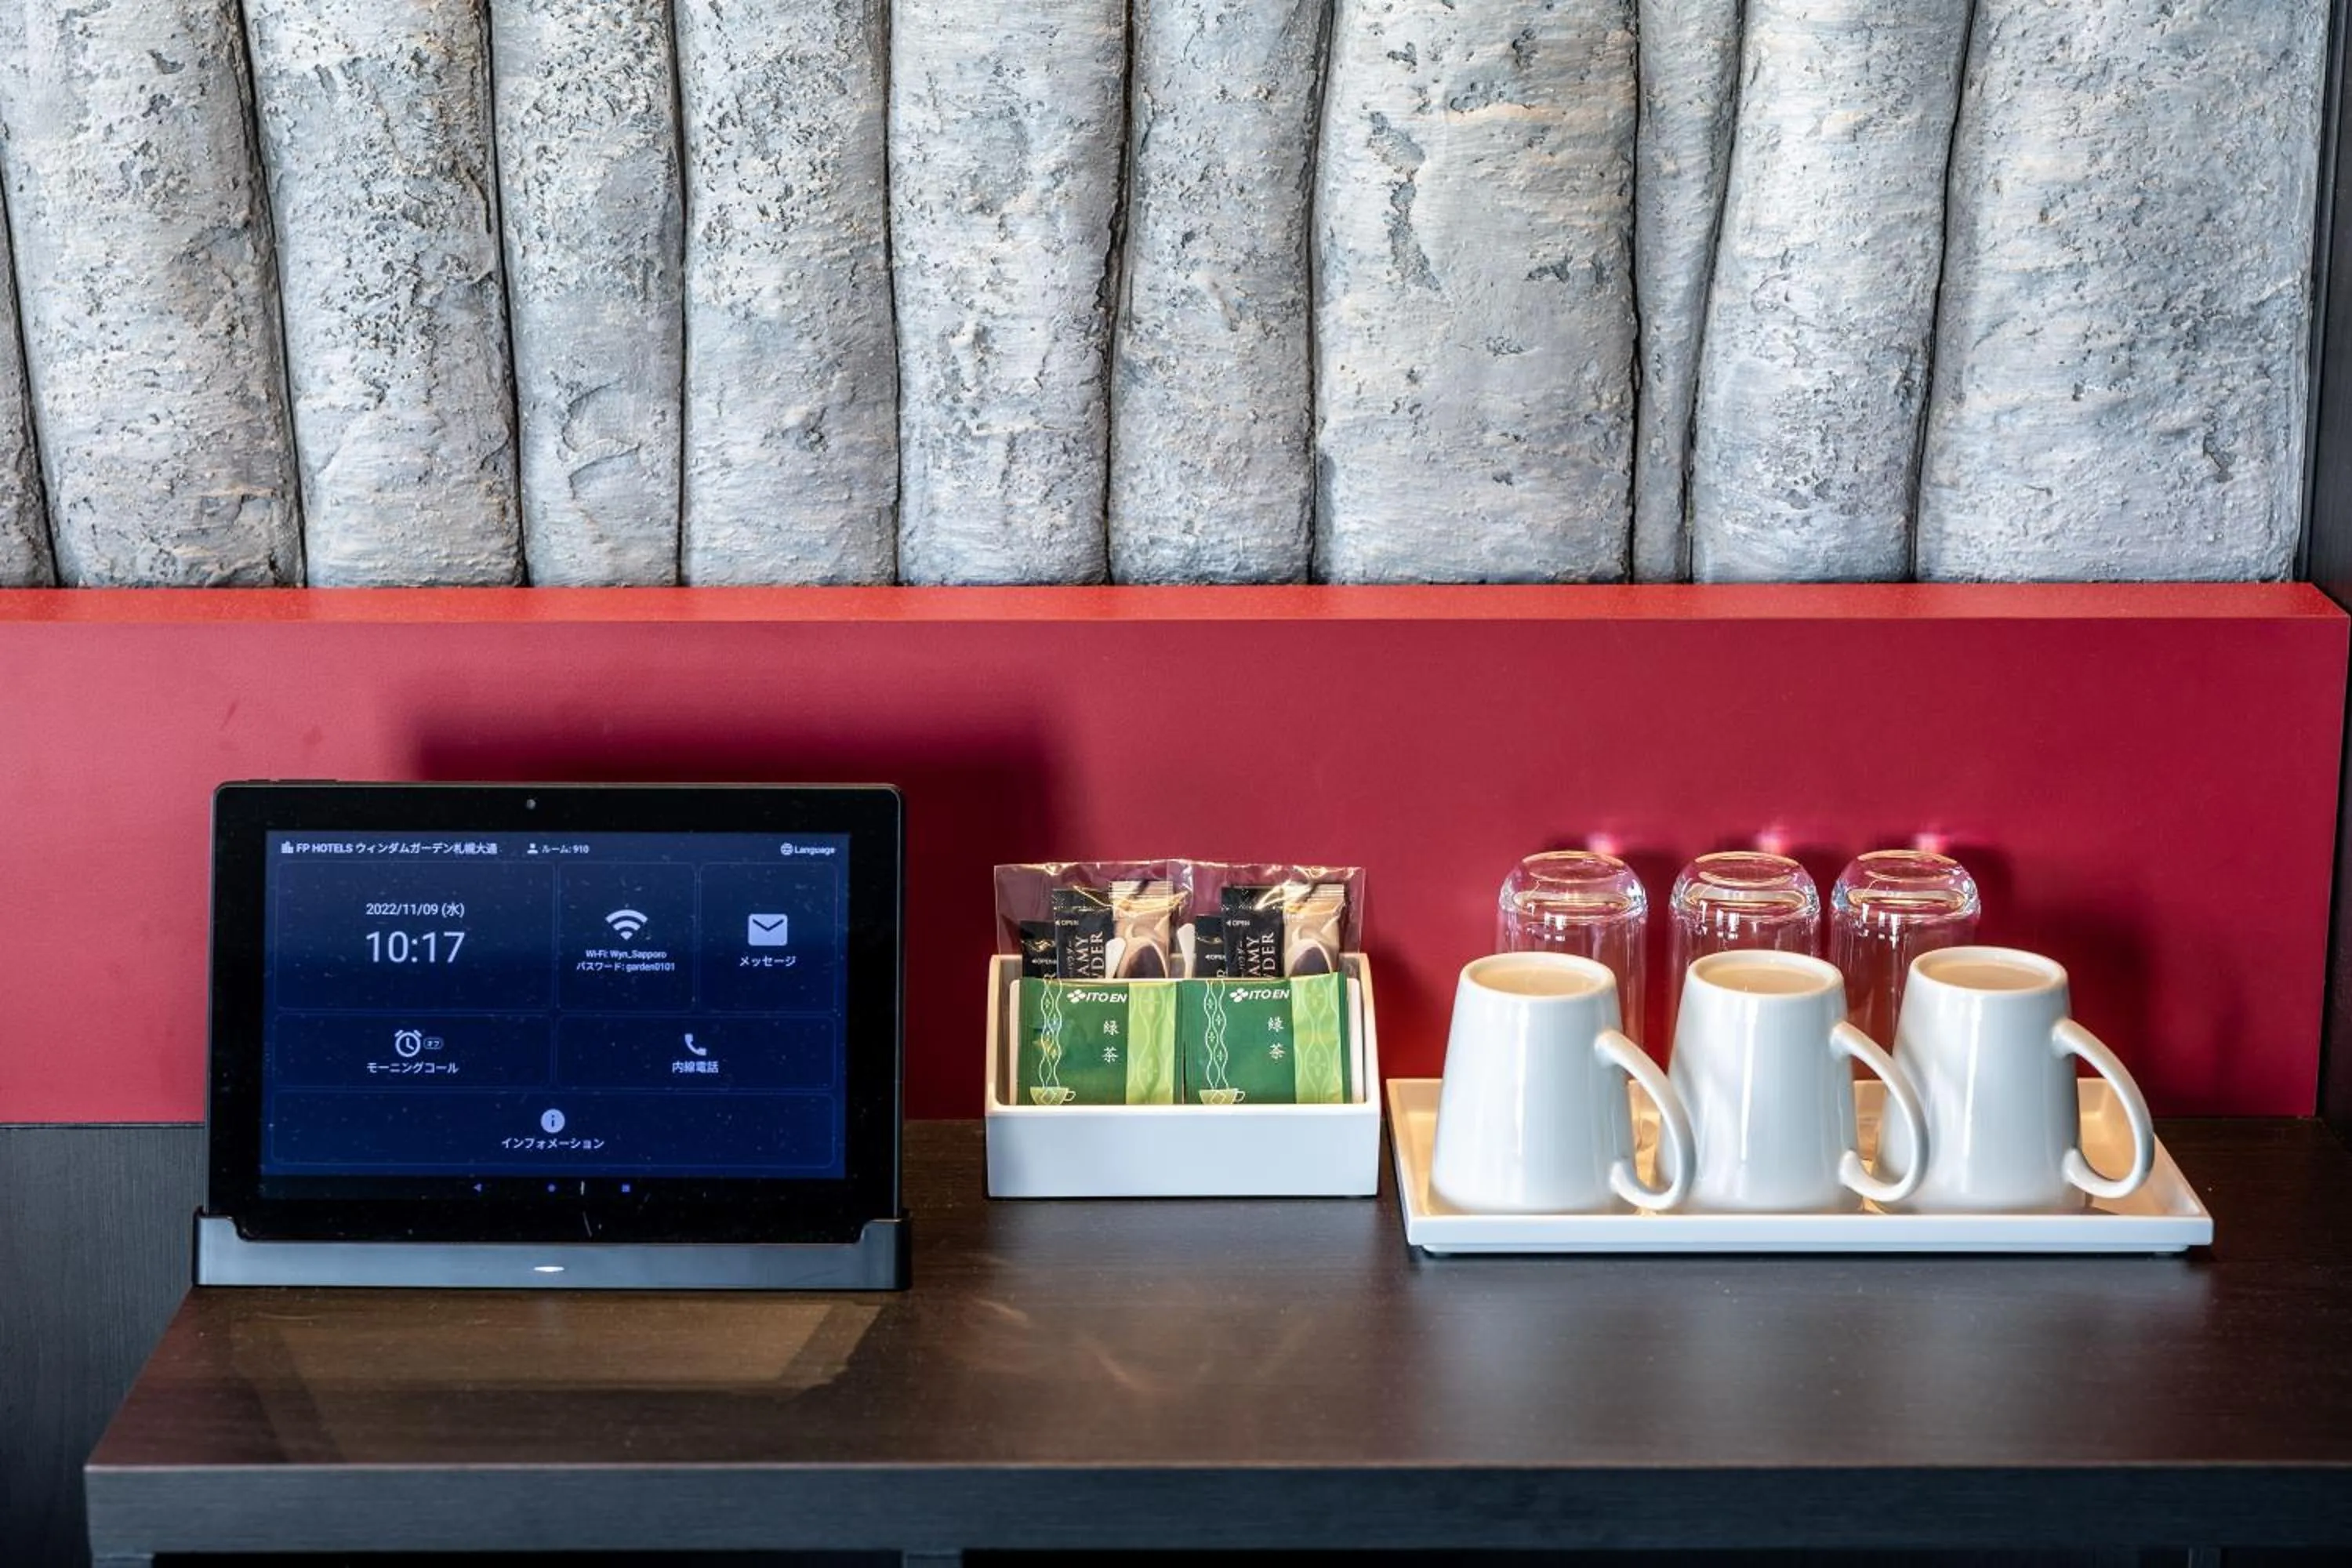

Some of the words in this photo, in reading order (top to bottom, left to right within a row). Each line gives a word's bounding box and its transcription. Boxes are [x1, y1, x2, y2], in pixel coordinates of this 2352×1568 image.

[296, 844, 310, 853] FP
[312, 844, 353, 854] HOTELS
[572, 844, 590, 854] 910
[794, 845, 835, 856] Language
[366, 903, 438, 916] 2022/11/09
[441, 903, 465, 918] (水)
[365, 931, 465, 964] 10:17
[609, 949, 667, 960] Wyn_Sapporo
[1090, 931, 1104, 978] DER
[1261, 931, 1276, 978] DER
[739, 956, 797, 967] メッセージ
[1085, 992, 1109, 1003] ITO
[1109, 993, 1127, 1004] EN
[1248, 989, 1271, 1000] ITO
[1272, 989, 1290, 1000] EN
[366, 1062, 460, 1074] モーニングコール
[672, 1061, 719, 1074] 内線電話
[501, 1138, 605, 1150] インフォメーション
